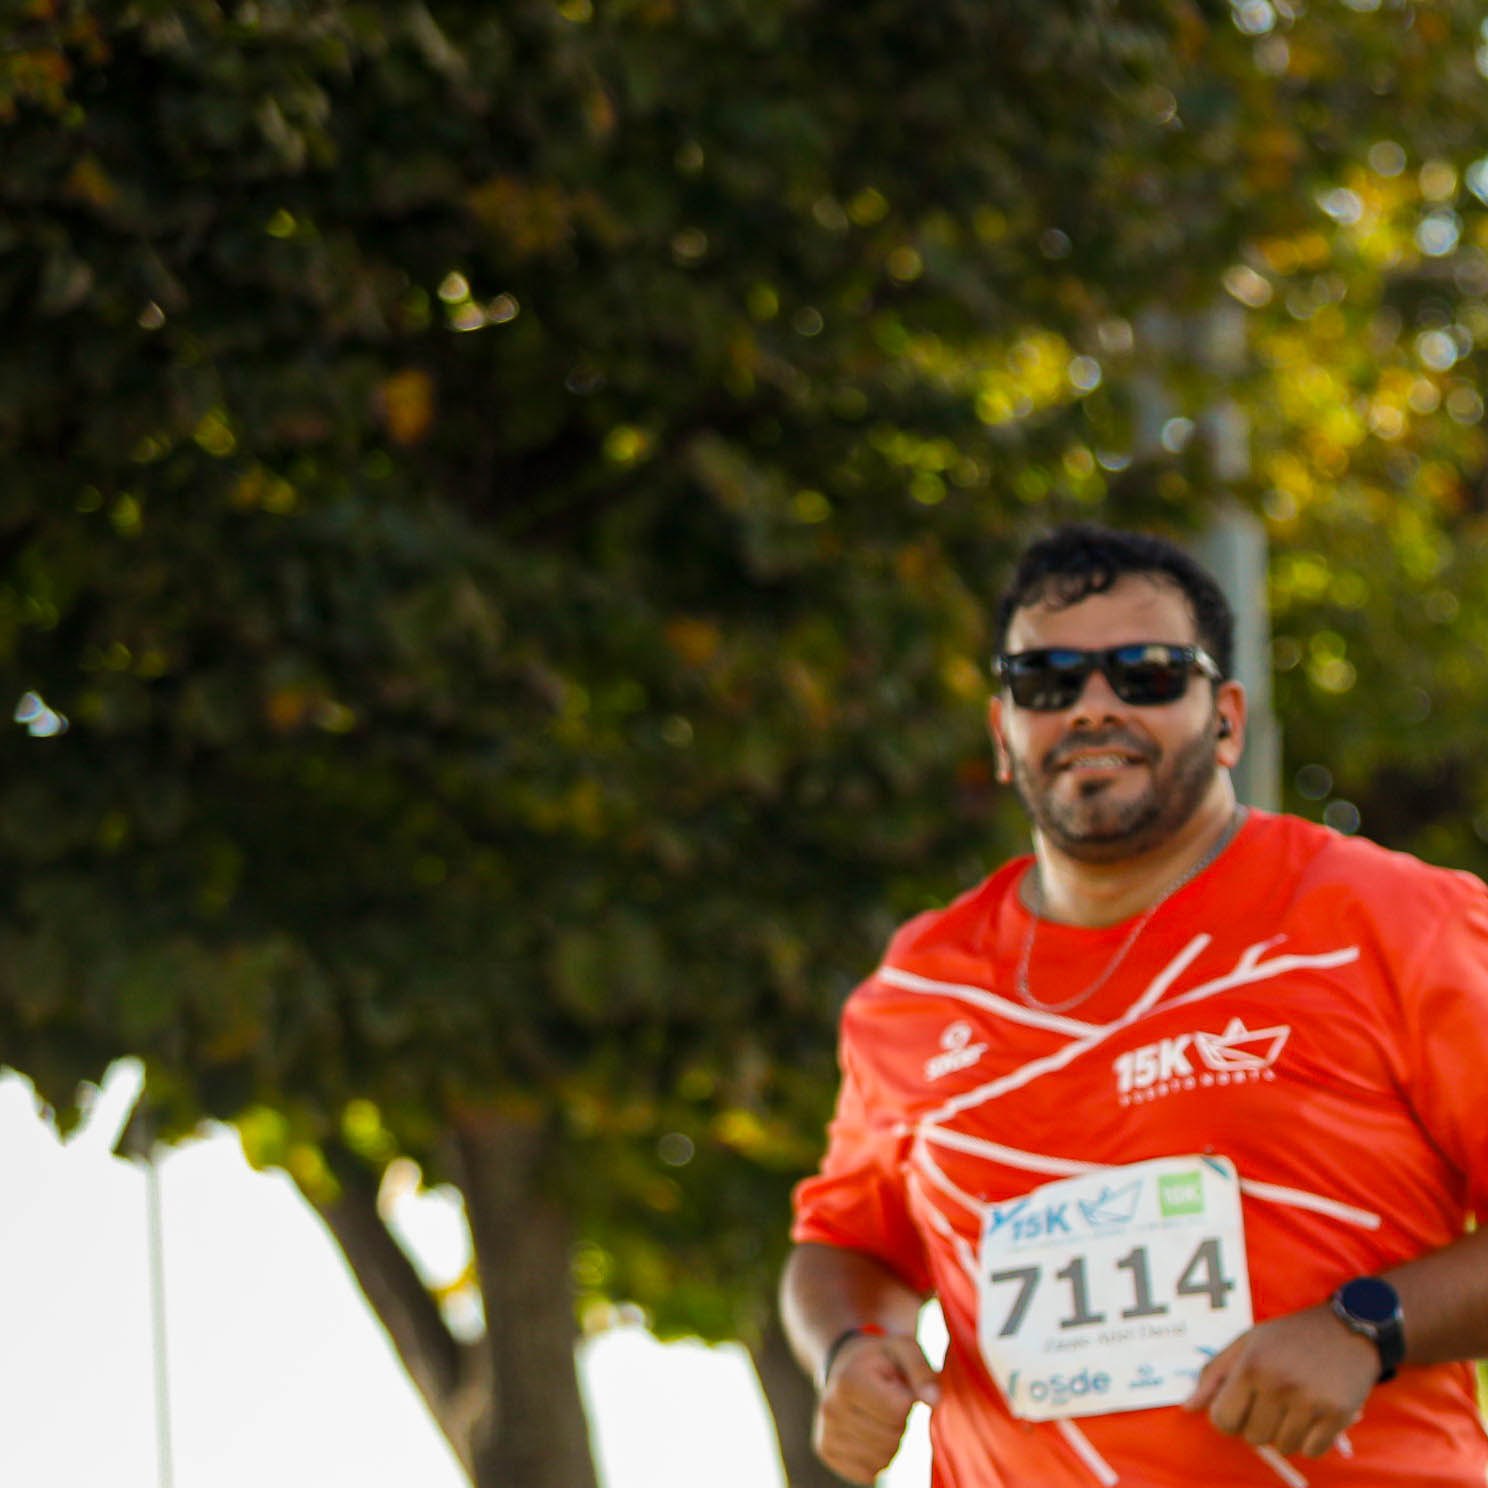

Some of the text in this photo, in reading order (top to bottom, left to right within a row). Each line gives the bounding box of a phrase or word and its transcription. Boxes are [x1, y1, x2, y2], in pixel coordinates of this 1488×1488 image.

[1113, 1033, 1194, 1092] 15K
[1012, 1202, 1073, 1241] 15K
[990, 1235, 1236, 1340] 7114
[1029, 1366, 1111, 1402] osde
